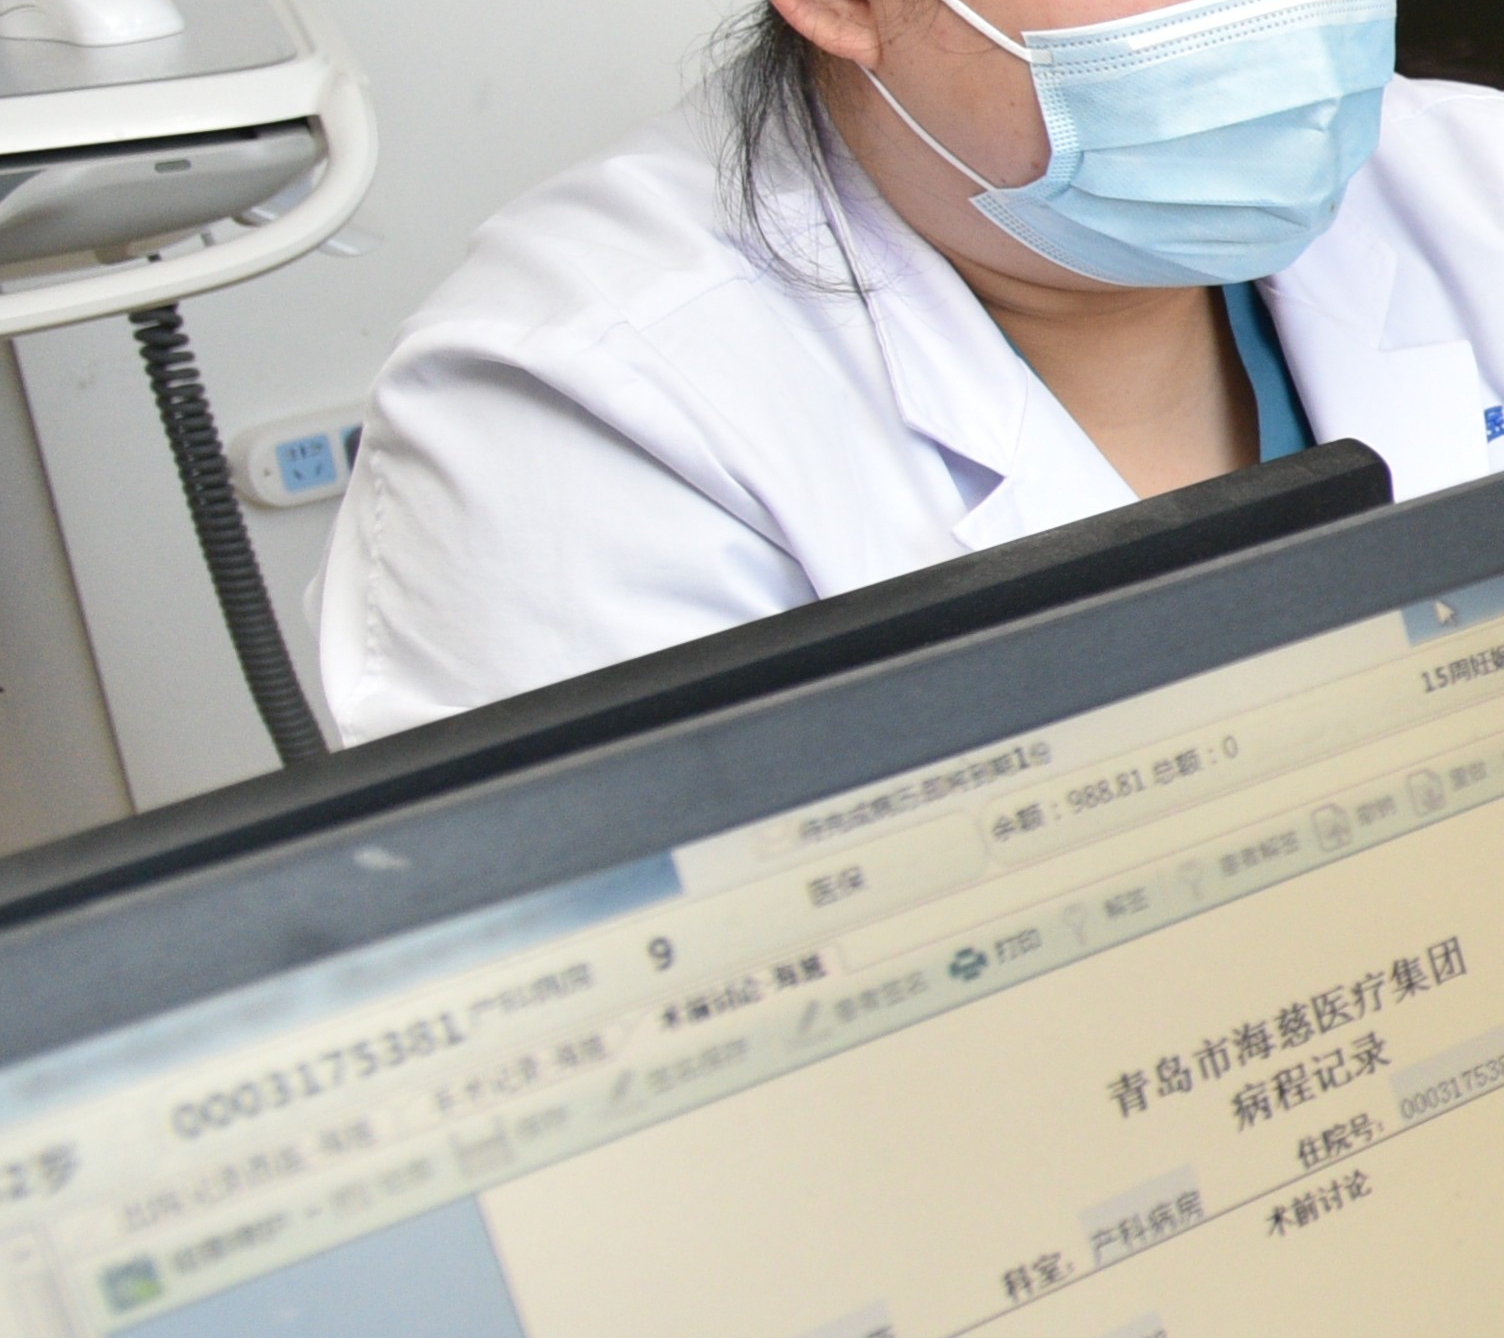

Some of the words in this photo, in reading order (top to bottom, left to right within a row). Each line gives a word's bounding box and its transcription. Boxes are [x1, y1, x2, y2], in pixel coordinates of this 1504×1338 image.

[806, 863, 868, 910] 医保
[170, 1005, 465, 1146] 0003175381
[647, 932, 678, 974] 9
[1106, 933, 1468, 1123] 青岛市海慈医疗集团
[1229, 1026, 1390, 1132] 病程记录
[1088, 1185, 1205, 1267] 产科病房
[1264, 1164, 1373, 1241] 术前讨论
